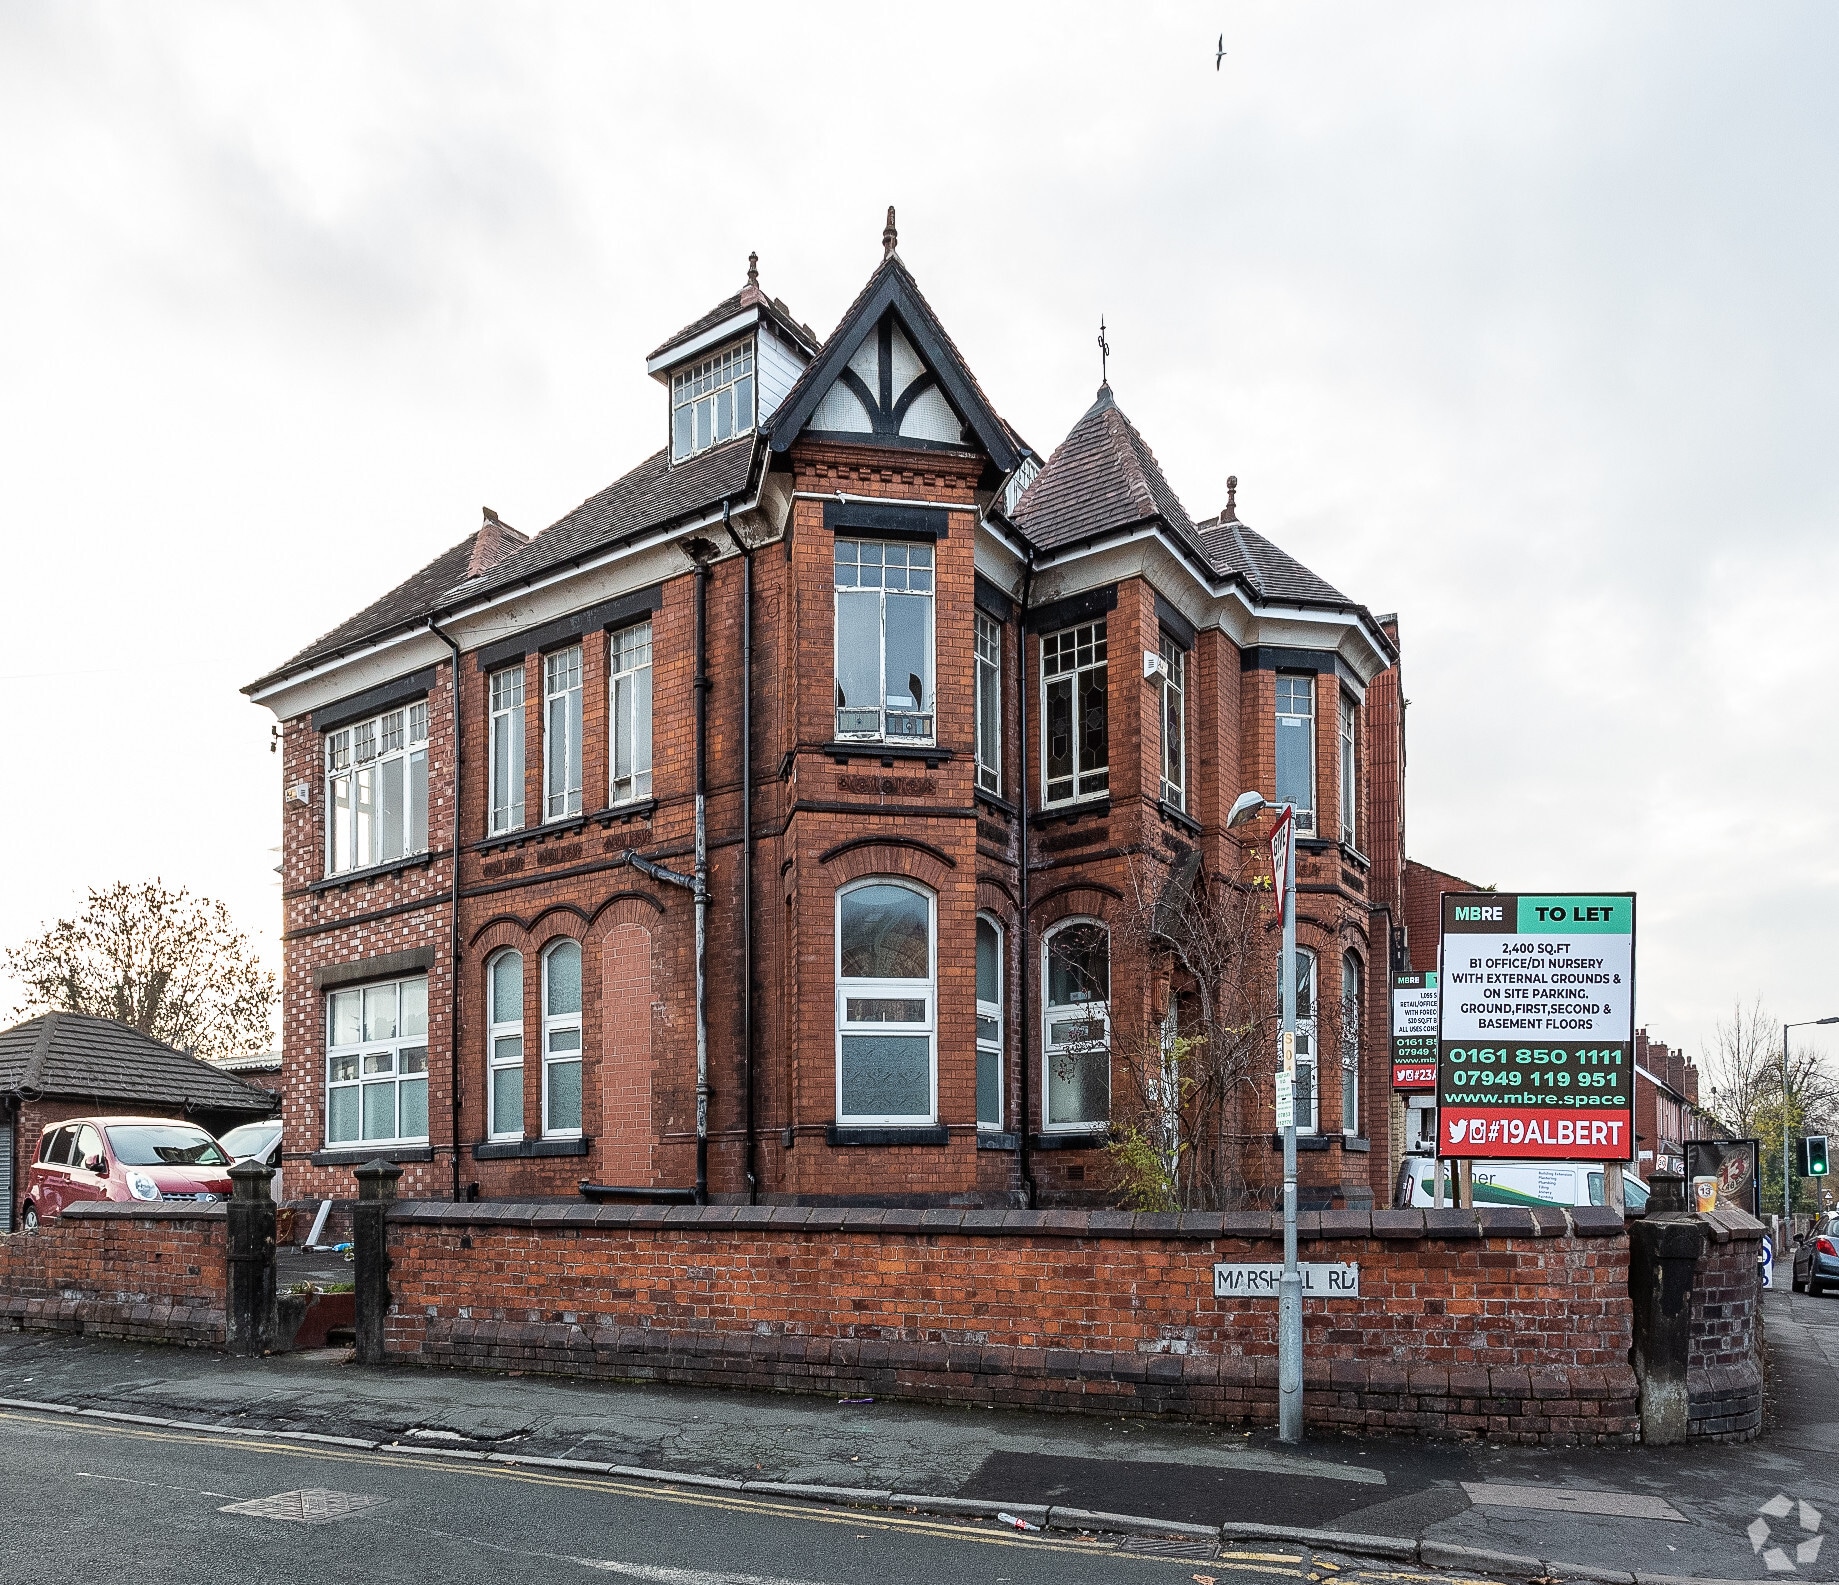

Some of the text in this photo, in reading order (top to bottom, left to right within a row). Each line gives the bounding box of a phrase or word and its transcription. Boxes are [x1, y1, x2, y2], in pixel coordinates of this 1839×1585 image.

[1274, 824, 1286, 857] GIVE
[1455, 906, 1502, 920] MBRE
[1535, 906, 1614, 922] TO LET
[1502, 943, 1571, 955] 2,400 SQ.FT
[1470, 957, 1603, 969] B1 OFFICE/D1 NURSERY
[1452, 973, 1621, 983] WITH EXTERNAL GROUNDS &
[1483, 988, 1589, 999] ON SITE PARKING.
[1460, 1003, 1612, 1016] GROUND,FIRST,SECOND &
[1478, 1018, 1593, 1029] BASEMENT FLOORS
[1450, 1048, 1622, 1064] 0161 850 1111
[1453, 1071, 1617, 1087] 07949 119 951
[1444, 1092, 1626, 1107] www.mbre.space
[1488, 1119, 1623, 1145] #19ALBERT
[1722, 1157, 1745, 1185] 13
[1218, 1270, 1314, 1290] MARSHL
